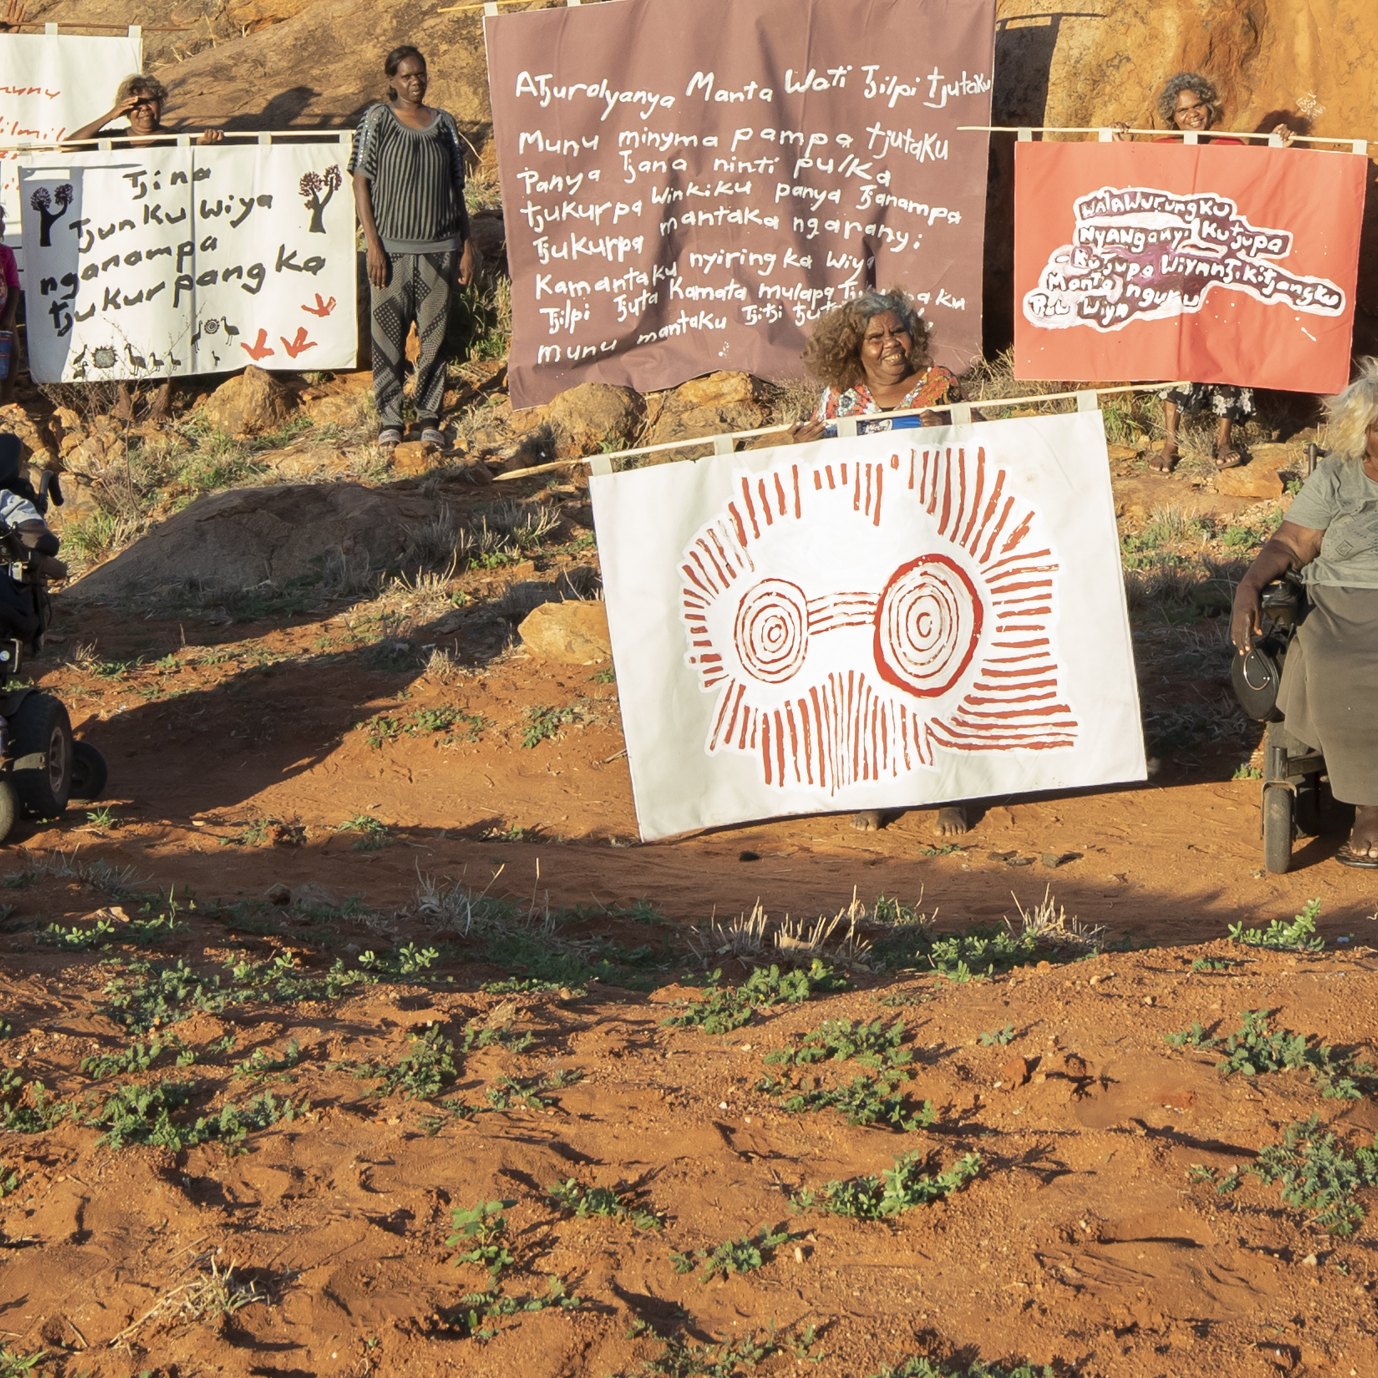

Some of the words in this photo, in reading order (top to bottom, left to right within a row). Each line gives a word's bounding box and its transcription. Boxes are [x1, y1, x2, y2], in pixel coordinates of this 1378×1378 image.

[685, 71, 773, 102] Manta
[785, 65, 852, 93] Wati
[519, 130, 599, 157] Munu
[619, 127, 718, 152] minyma
[731, 128, 854, 158] pampa
[619, 150, 687, 183] Tjana
[714, 156, 780, 174] ninti
[775, 183, 841, 211] panya
[535, 262, 677, 300] Kamantaku
[539, 300, 590, 334] Tjilpi
[614, 289, 658, 322] Tjuta
[759, 282, 834, 308] mulapa
